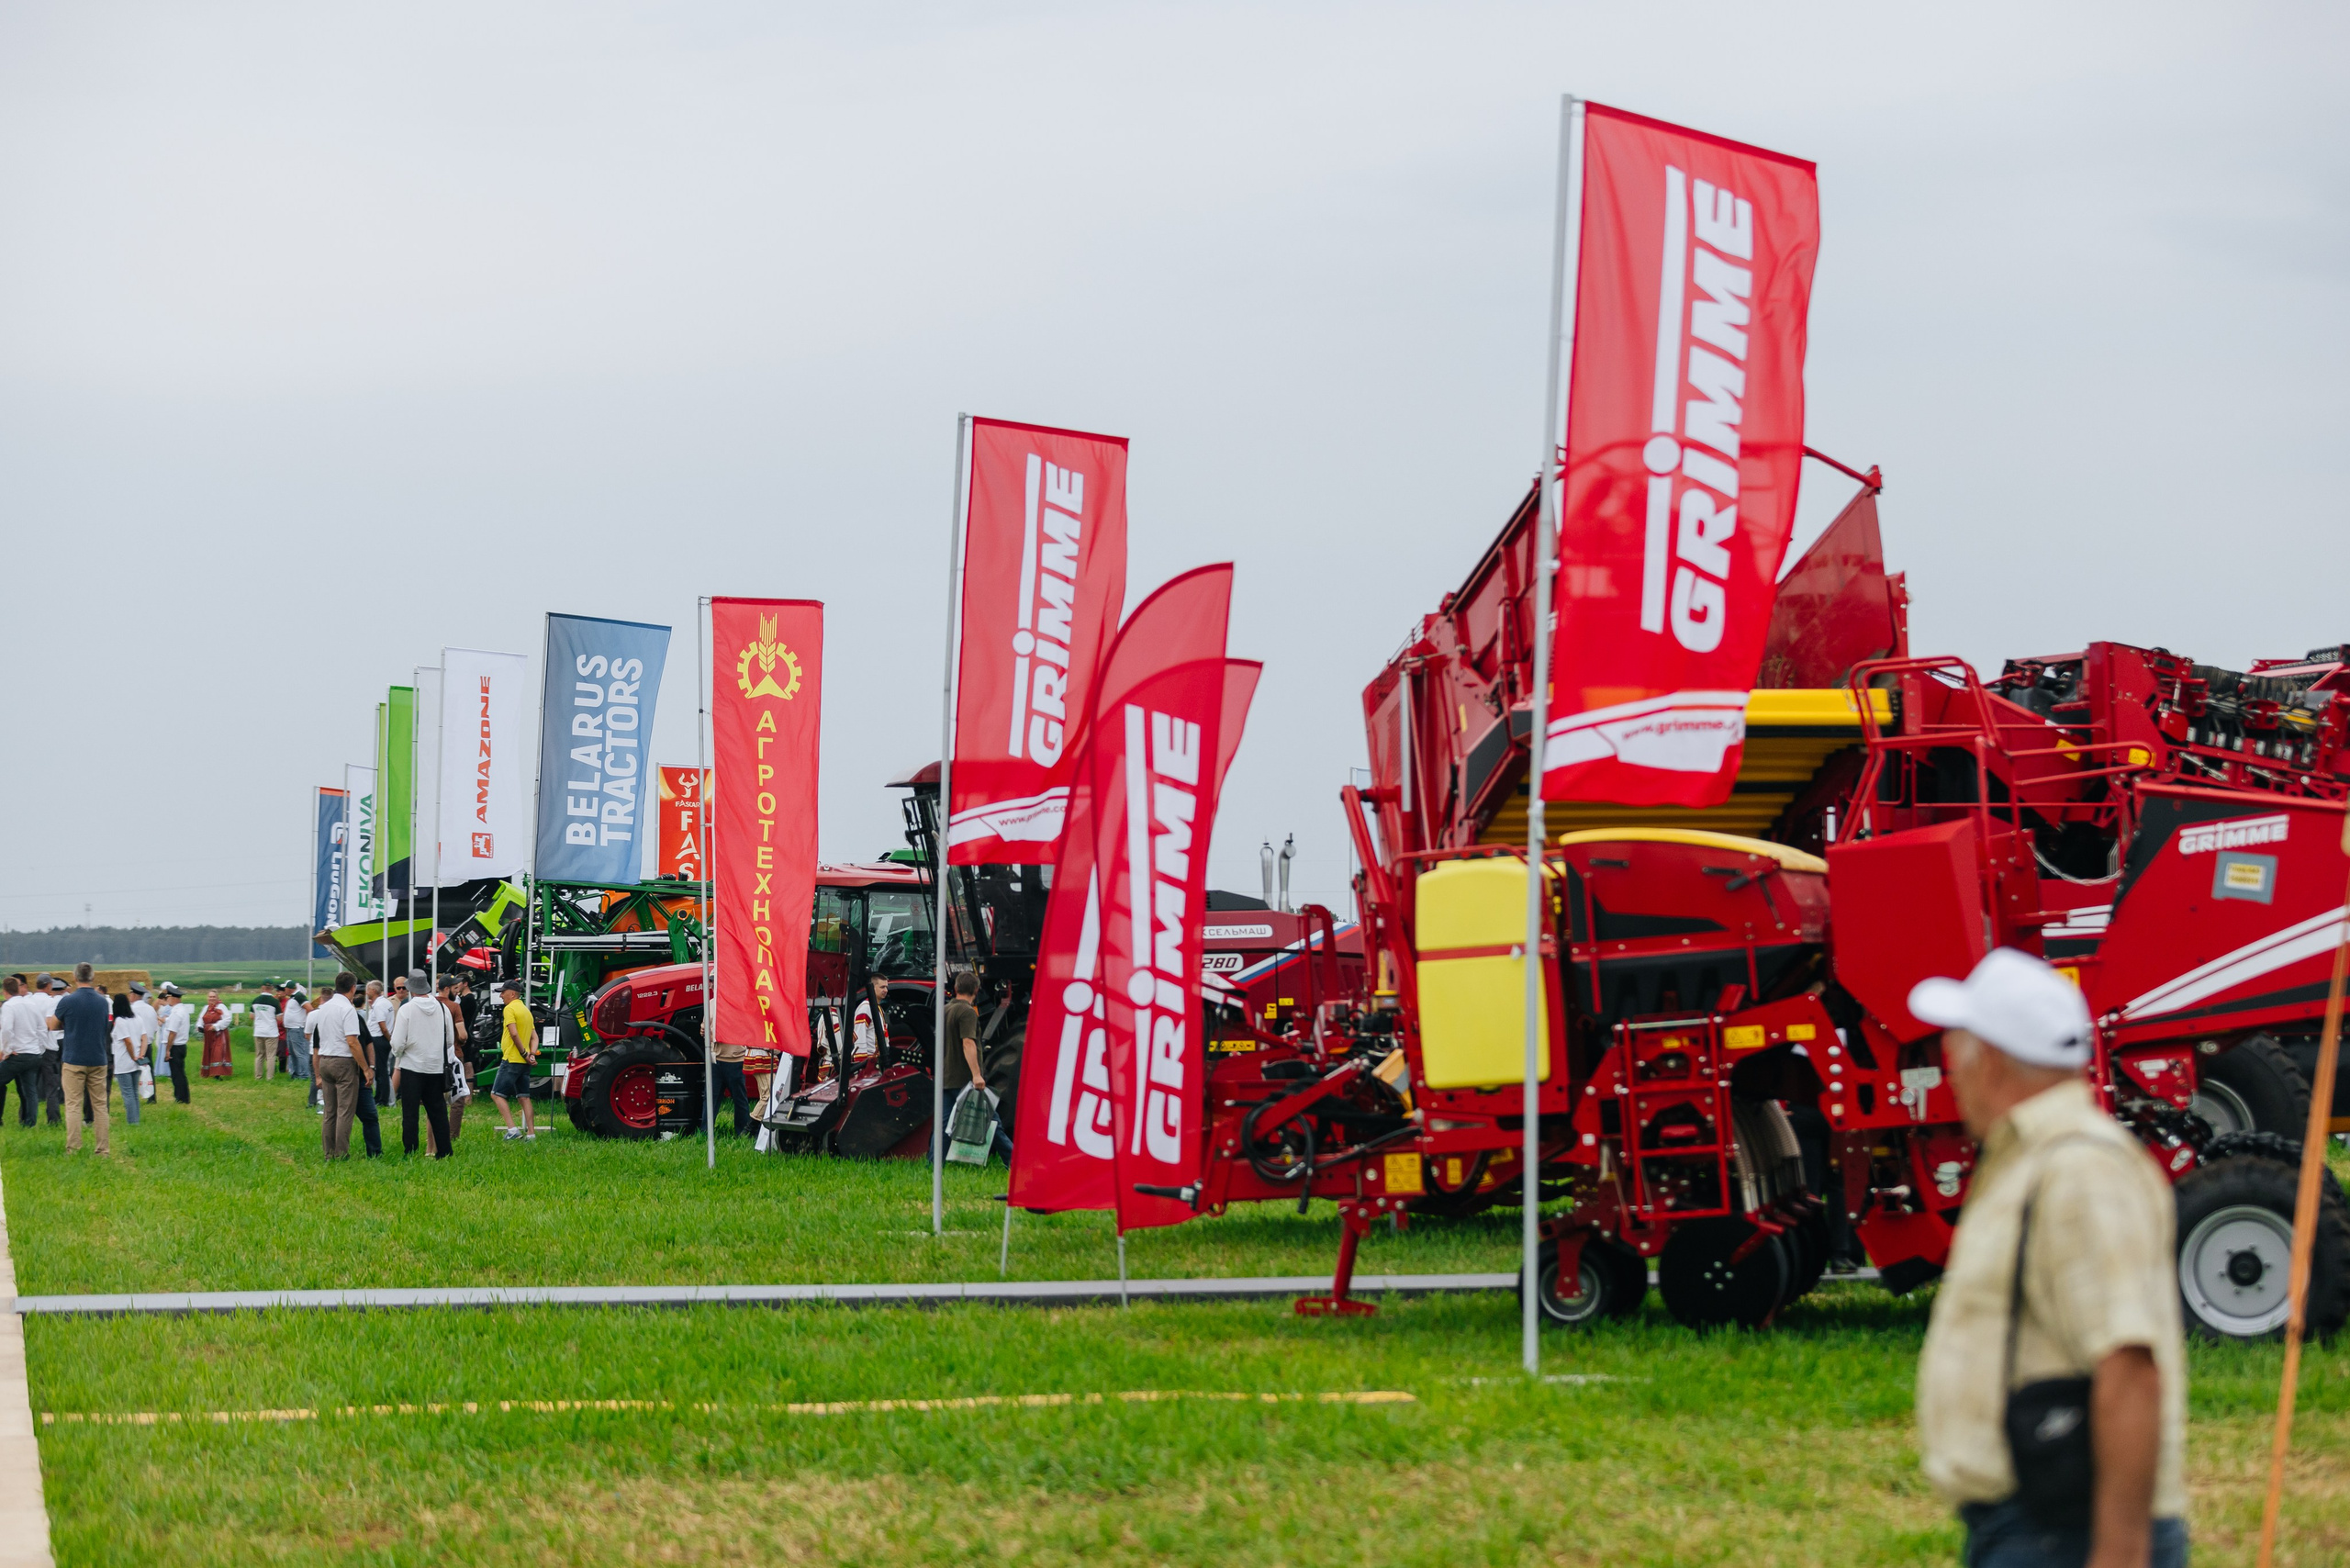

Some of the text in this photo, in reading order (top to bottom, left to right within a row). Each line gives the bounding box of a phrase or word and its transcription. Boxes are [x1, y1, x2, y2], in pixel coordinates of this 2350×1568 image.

[1641, 165, 1753, 654] GRIMME
[1010, 453, 1085, 769] GRIMME
[476, 676, 492, 824] AMAZONE
[565, 654, 609, 846] BELARUS
[599, 657, 643, 847] TRACTORS
[2178, 813, 2290, 855] GRIMME
[326, 852, 344, 926] LIUGON
[753, 710, 778, 1044] АГРОТЕХНОПАРК
[1125, 703, 1201, 1165] GRIMME
